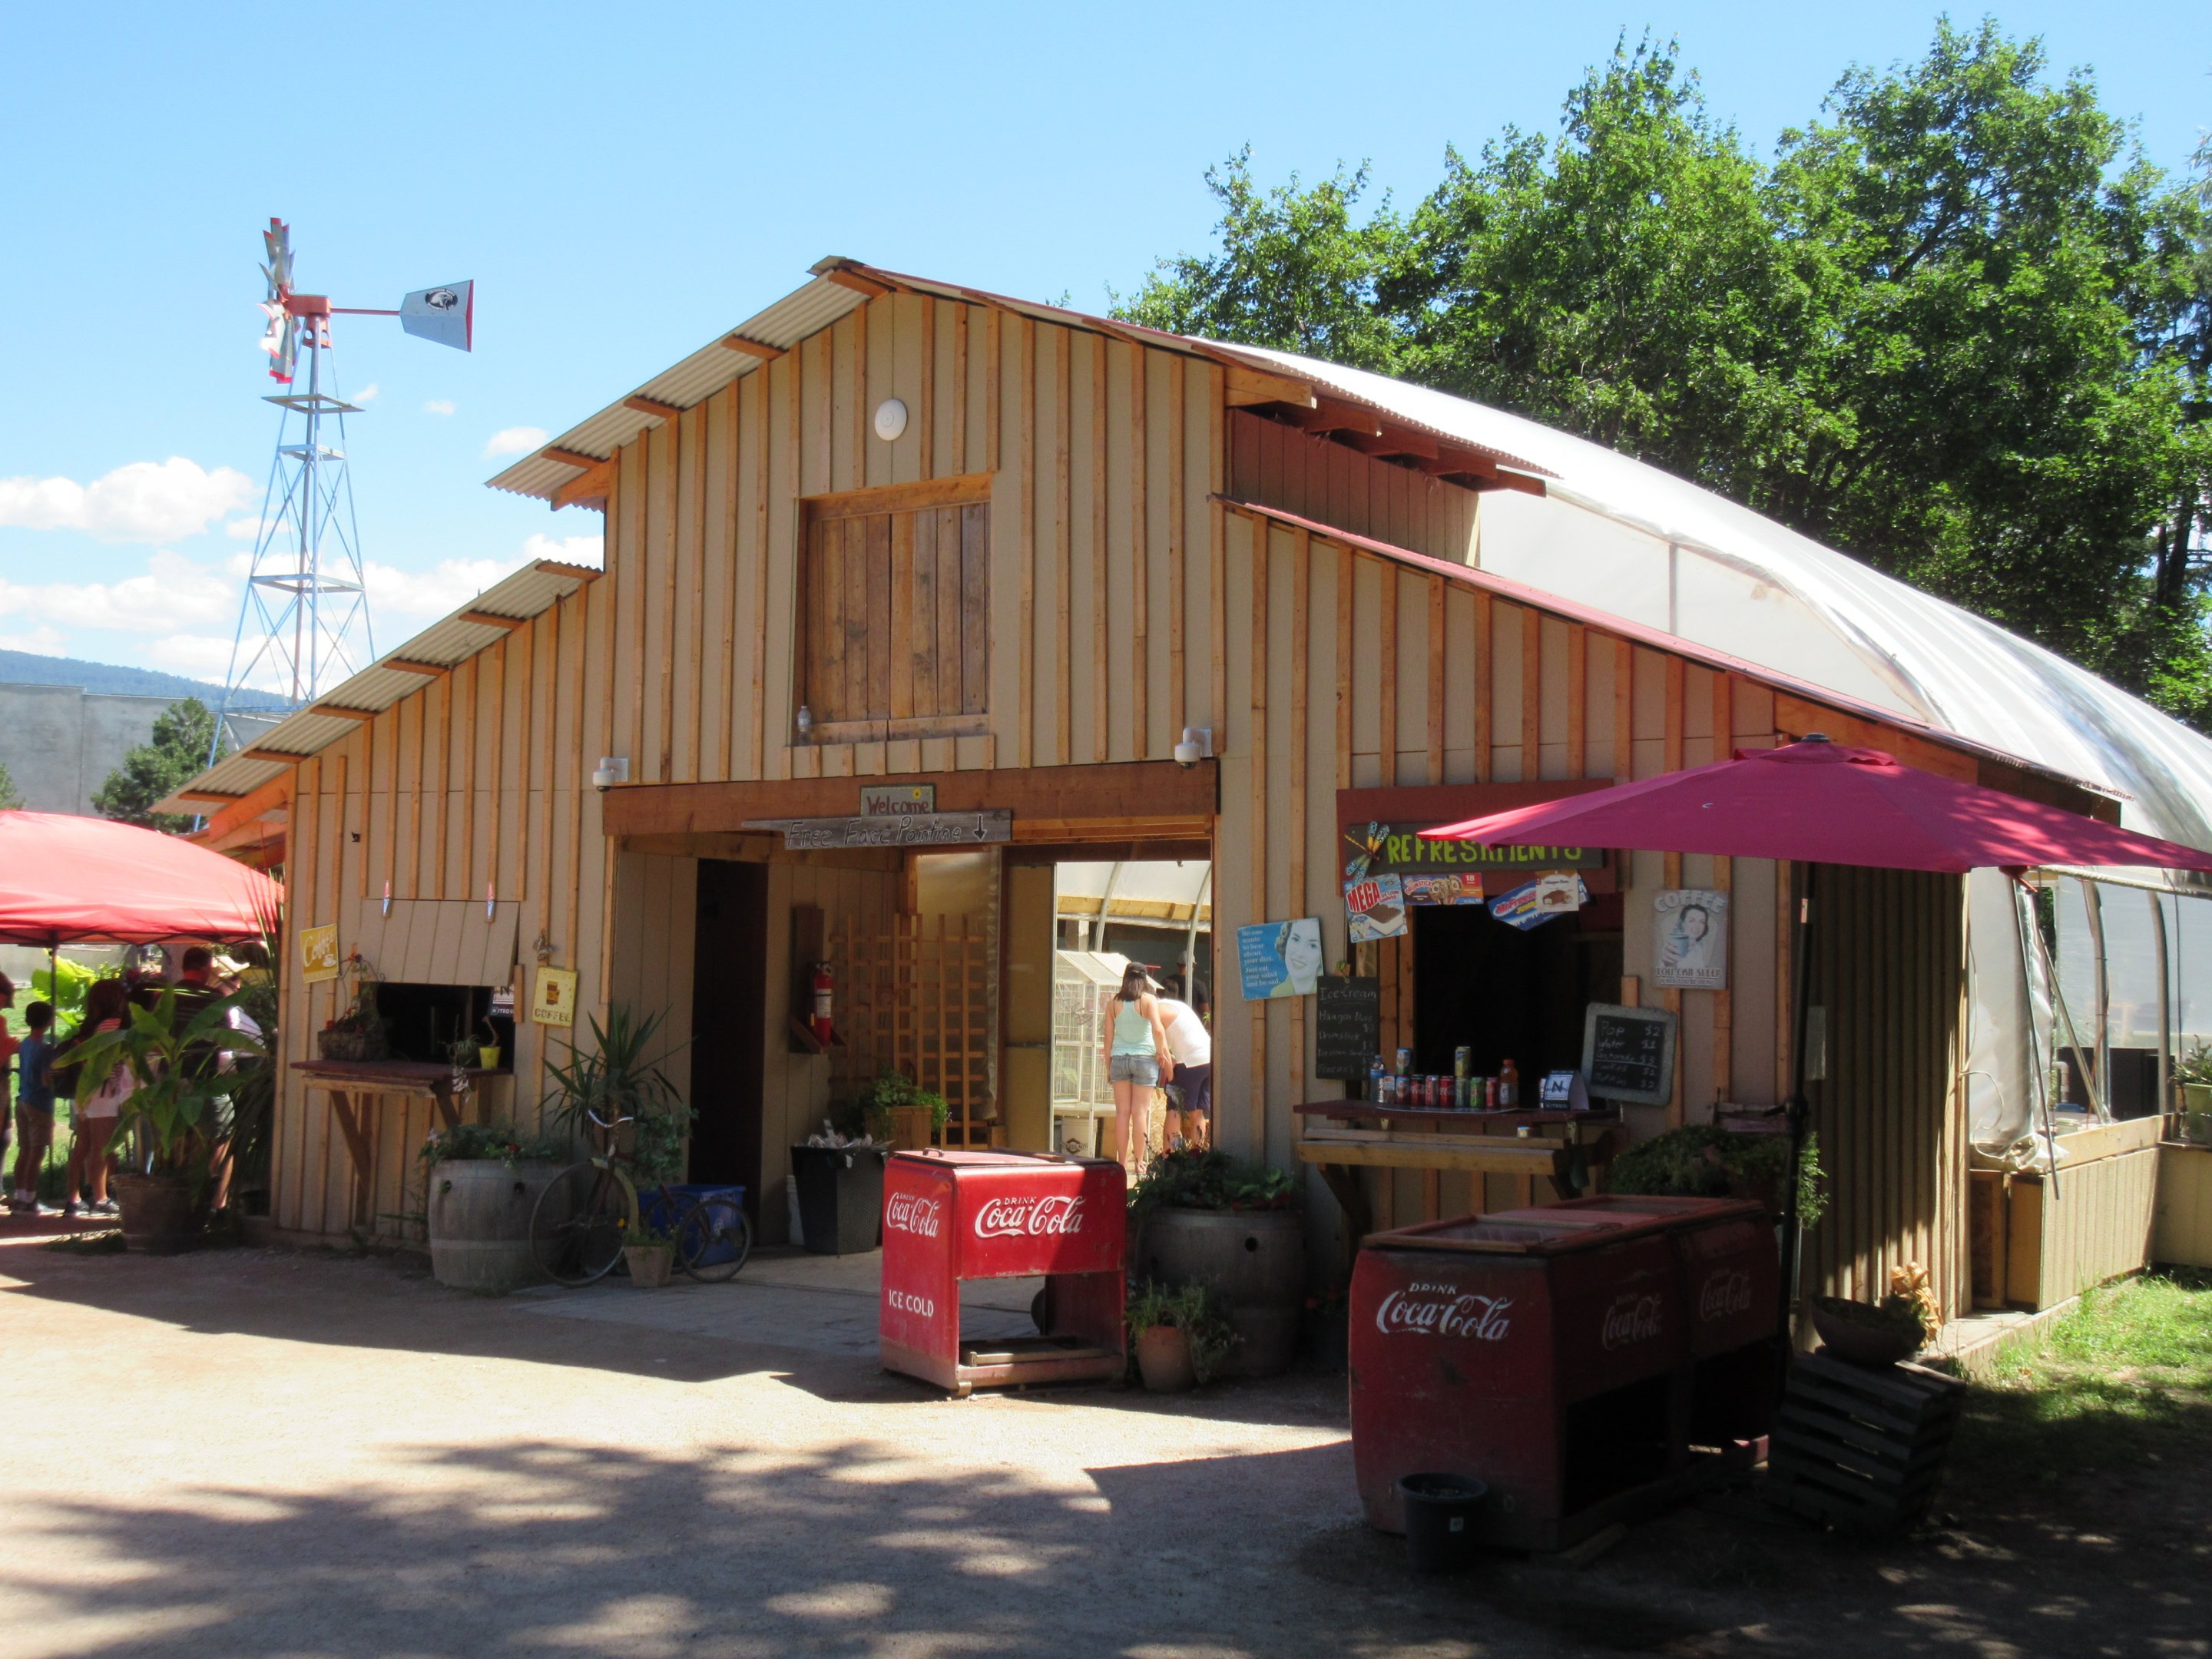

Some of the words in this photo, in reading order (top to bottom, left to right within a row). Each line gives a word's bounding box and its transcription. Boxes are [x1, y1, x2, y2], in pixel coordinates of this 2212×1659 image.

[867, 796, 929, 814] Welcome
[786, 820, 832, 847] Free
[844, 818, 892, 846] Face
[896, 815, 962, 843] Painting
[1346, 881, 1381, 913] MEGA
[1654, 890, 1725, 913] COFFEE
[303, 929, 336, 968] Coffee
[1655, 968, 1674, 977] YOU
[1676, 969, 1694, 977] CAN
[1697, 969, 1721, 978] SLEEP
[534, 1008, 571, 1023] COFFEE
[1601, 1020, 1626, 1037] Pop
[1644, 1024, 1661, 1036] $2
[1641, 1039, 1657, 1049] $1
[888, 1192, 942, 1237] Coca-Cola
[1003, 1196, 1038, 1206] DRINK
[975, 1195, 1087, 1238] Coca-Cola
[1409, 1282, 1459, 1295] DRINK
[1700, 1271, 1751, 1321] Coca-Cola
[889, 1289, 904, 1310] ICE
[906, 1294, 935, 1318] COLD
[1376, 1290, 1518, 1341] Coca-Cola
[1602, 1294, 1663, 1351] Coca-Cola
